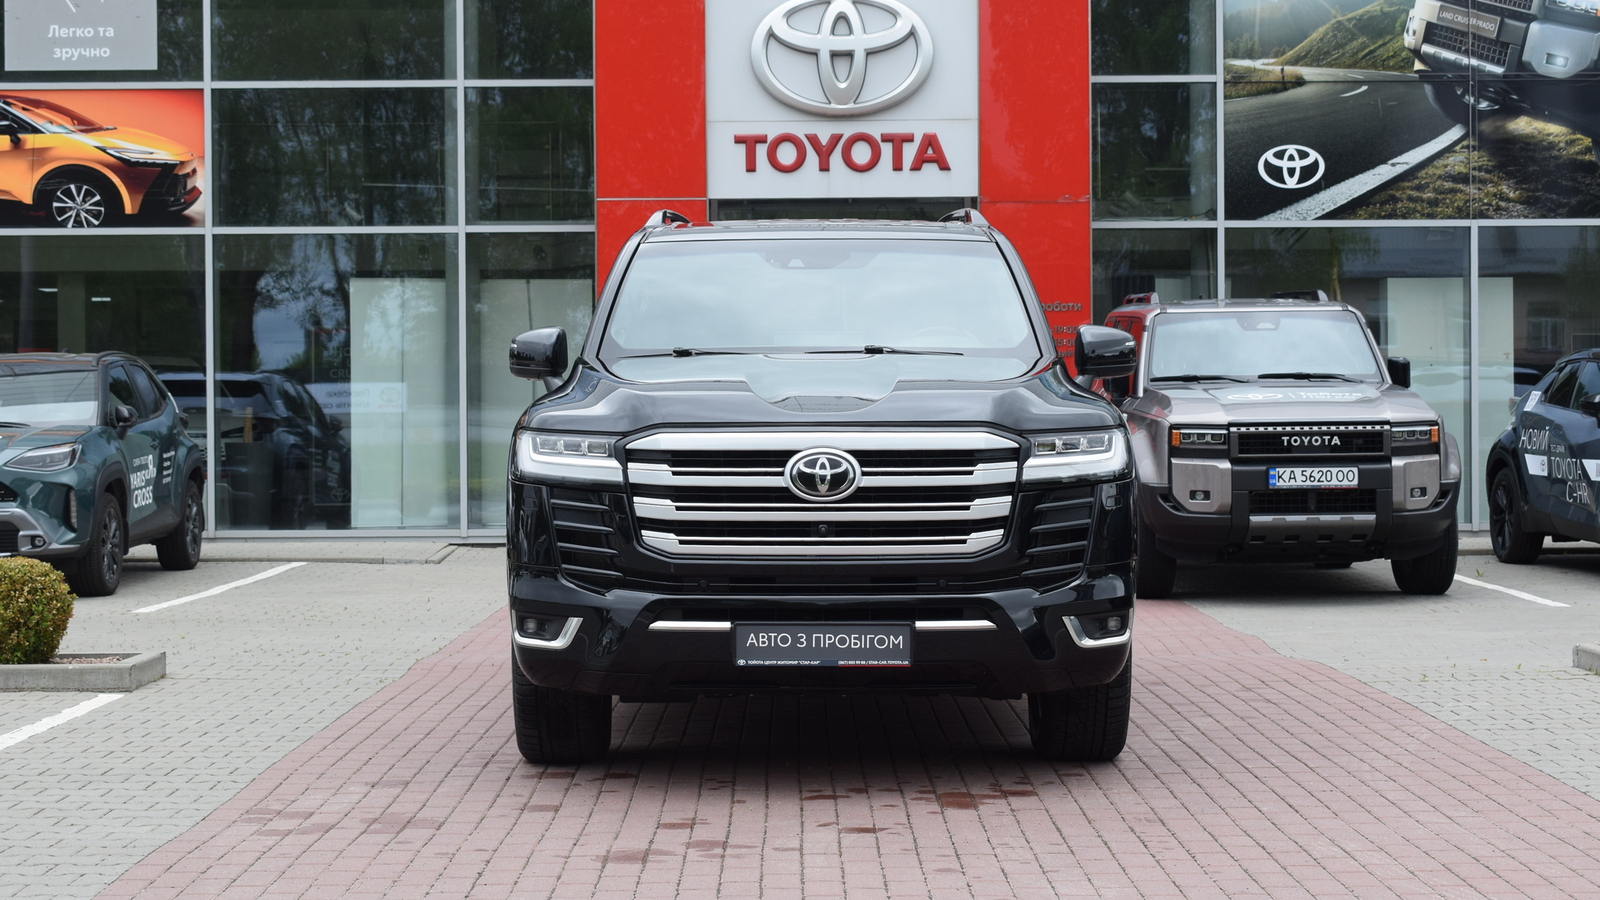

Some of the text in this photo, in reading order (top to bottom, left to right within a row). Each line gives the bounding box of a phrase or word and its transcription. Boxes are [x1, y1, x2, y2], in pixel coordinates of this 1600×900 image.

[1439, 10, 1495, 31] LAND CRUISER PRADO
[47, 24, 115, 38] Легко та
[52, 46, 111, 61] зручно
[733, 132, 952, 173] TOYOTA
[1282, 436, 1341, 446] TOYOTA
[1519, 426, 1549, 451] НОВИЙ
[1277, 470, 1297, 483] KA
[1300, 470, 1333, 483] 5620
[1551, 457, 1584, 480] TOYOTA
[130, 469, 146, 489] YARIS
[133, 485, 153, 508] CROSS
[1566, 481, 1590, 504] C-HR
[746, 632, 903, 649] АВТО З ПРОБІГОМ
